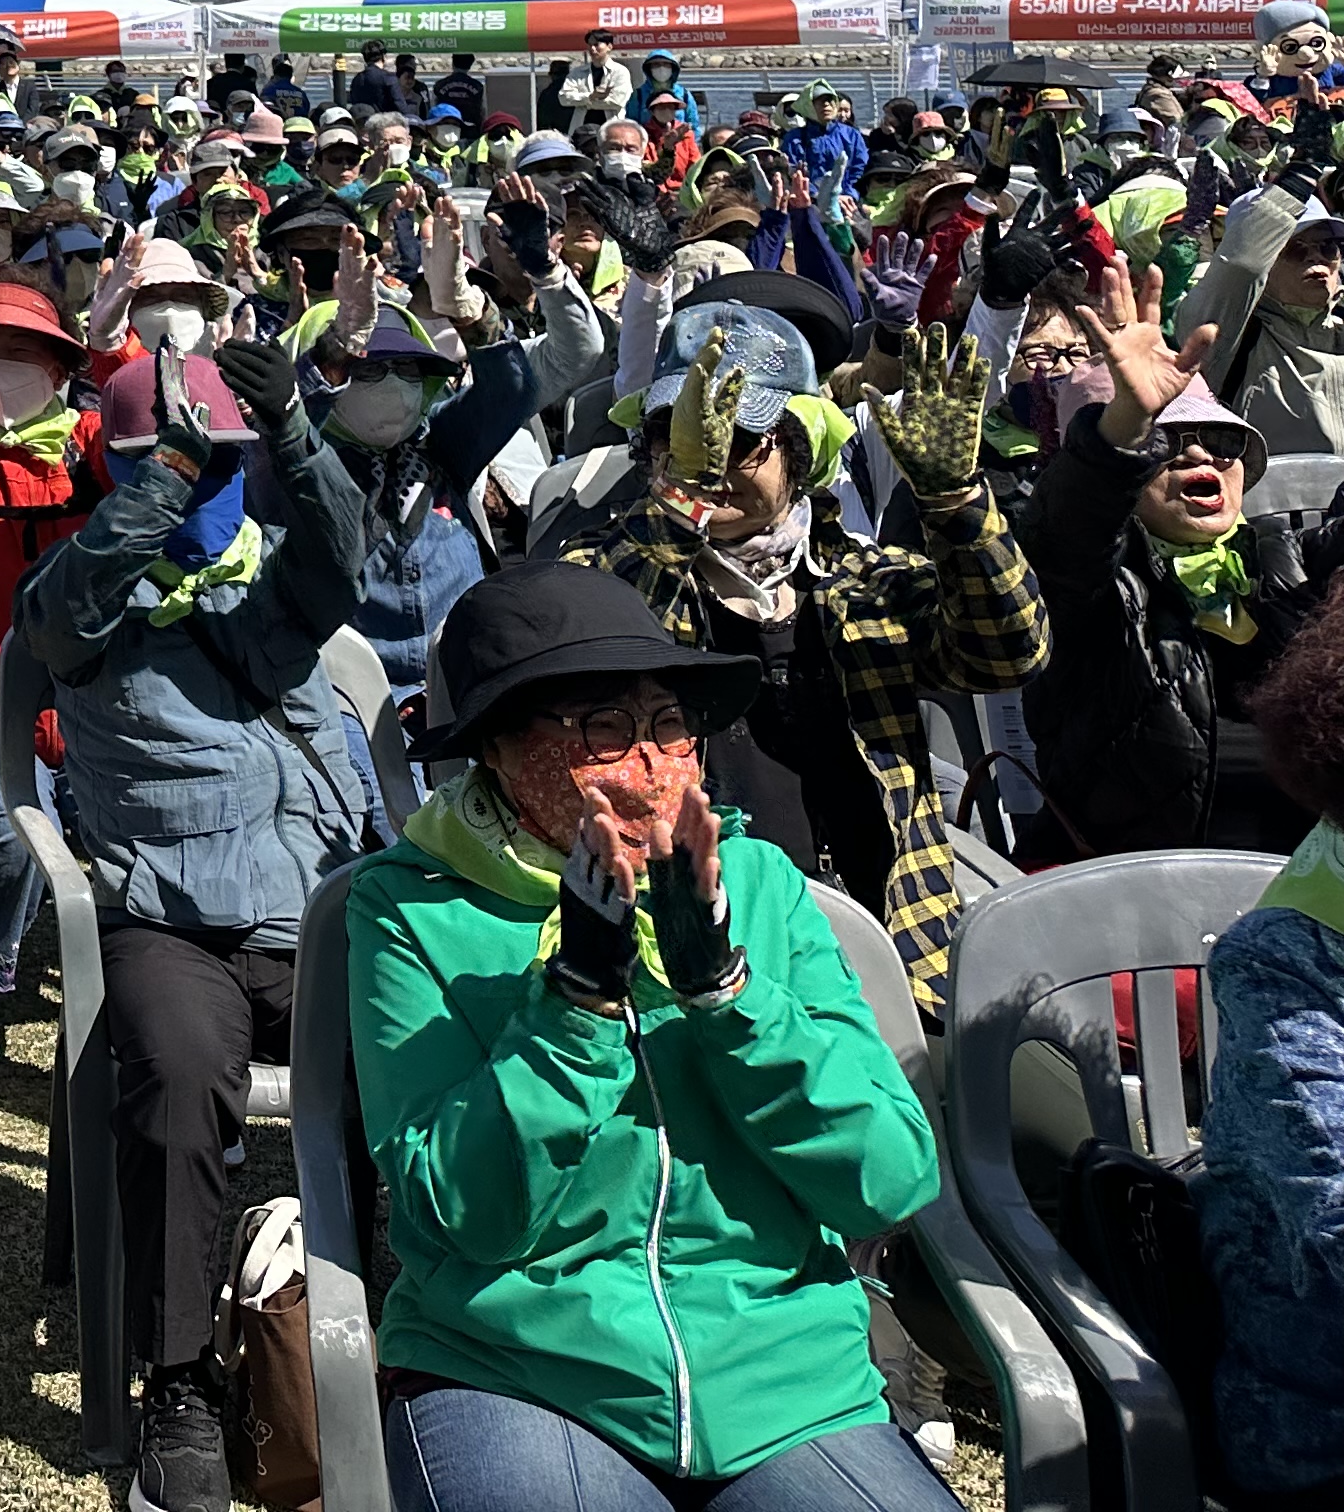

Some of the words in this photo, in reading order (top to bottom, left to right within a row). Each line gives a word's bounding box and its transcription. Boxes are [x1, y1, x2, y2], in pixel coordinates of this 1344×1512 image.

[299, 12, 383, 32] 건강정보
[390, 12, 412, 31] 및
[417, 10, 507, 31] 체험활동
[598, 6, 669, 28] 테이핑
[675, 4, 724, 25] 체험
[22, 18, 68, 40] 판매
